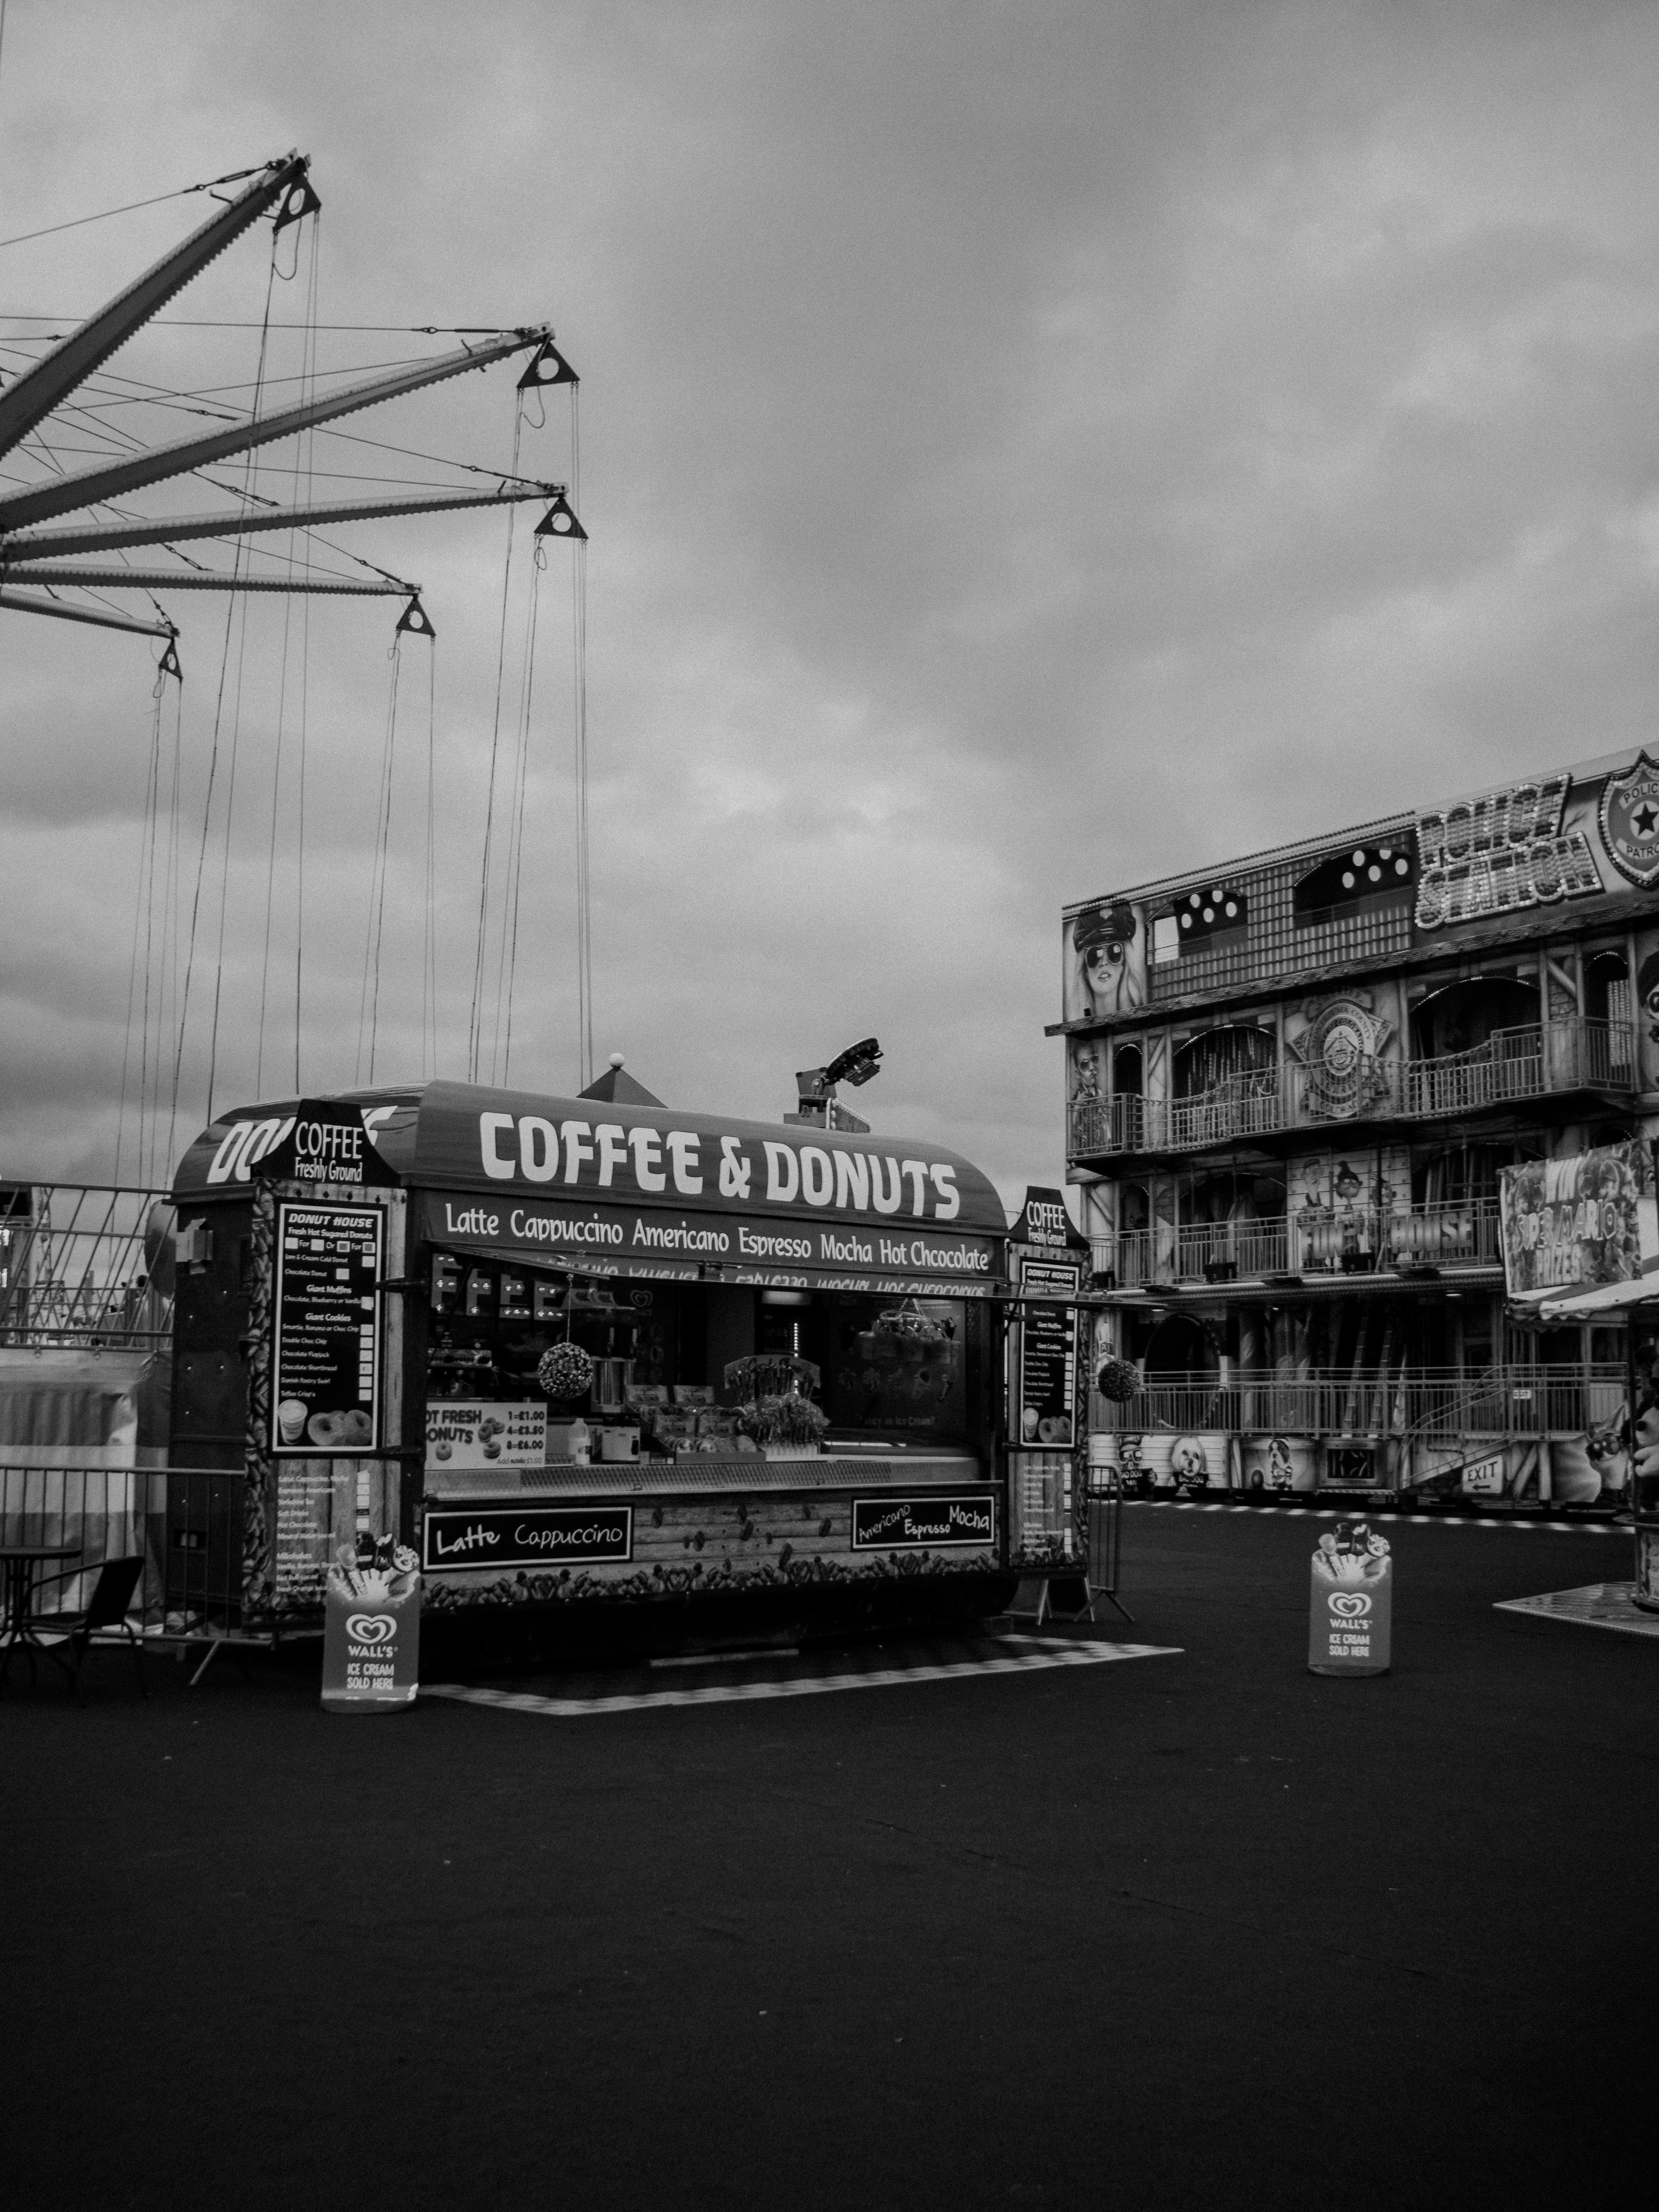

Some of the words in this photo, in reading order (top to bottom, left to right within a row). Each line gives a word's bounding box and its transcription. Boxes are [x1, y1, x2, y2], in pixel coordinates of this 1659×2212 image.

[296, 1121, 363, 1159] COFFEE
[295, 1157, 327, 1182] Freshly
[329, 1160, 363, 1182] Ground
[480, 1112, 703, 1194] COFFEE
[719, 1136, 751, 1199] &
[763, 1141, 960, 1219] DONUTS
[288, 1214, 332, 1225] DONUT
[333, 1217, 374, 1228] HOUSE
[1027, 1201, 1065, 1229] COFFEE
[1556, 1199, 1616, 1246] MARIO
[288, 1227, 306, 1235] Fresh
[308, 1228, 320, 1236] Hot
[321, 1229, 349, 1239] Sugared
[350, 1231, 373, 1239] Donuts
[445, 1202, 499, 1235] Latte
[510, 1209, 623, 1244] Cappuccino
[632, 1218, 729, 1252] Americano
[738, 1227, 812, 1257] Espresso
[820, 1234, 873, 1263] Mocha
[879, 1239, 908, 1265] Hot
[910, 1241, 990, 1270] Chcocolate
[1391, 1212, 1473, 1254] HOUSE
[306, 1284, 325, 1292] Giant
[326, 1286, 352, 1294] Muffins
[325, 1313, 352, 1321] Cookies
[442, 1410, 482, 1425] FRESH
[426, 1427, 474, 1444] ONUTS
[1468, 1461, 1498, 1482] EXIT
[859, 1504, 911, 1542] Americano
[904, 1518, 951, 1540] Espresso
[949, 1505, 990, 1531] Mocha
[437, 1524, 501, 1555] Latte
[515, 1524, 623, 1549] Cappuccino
[1330, 1618, 1369, 1630] WALL'S
[1329, 1633, 1341, 1644] ICE
[1342, 1634, 1370, 1645] CREAM
[347, 1645, 393, 1658] WALL'S
[1329, 1645, 1349, 1656] SOLD
[1351, 1645, 1370, 1656] HERE
[347, 1663, 361, 1676] ICE
[363, 1663, 395, 1676] CREAM
[346, 1677, 370, 1689] SOLD
[372, 1677, 394, 1690] HERE
